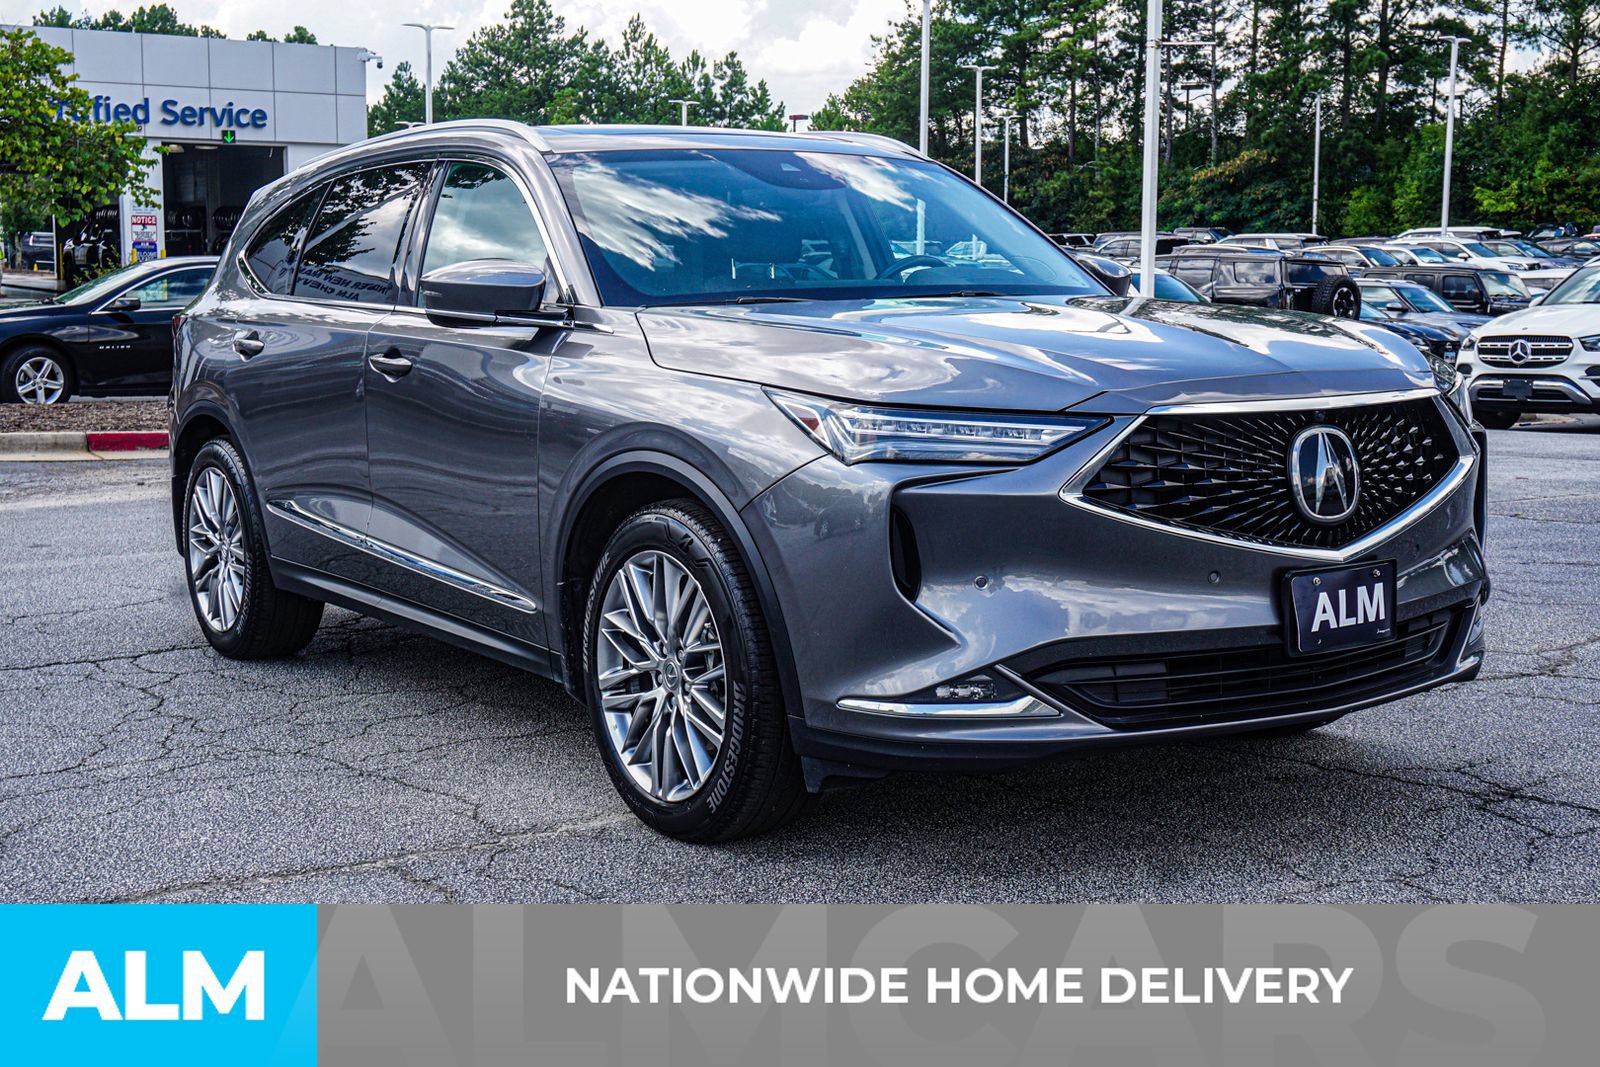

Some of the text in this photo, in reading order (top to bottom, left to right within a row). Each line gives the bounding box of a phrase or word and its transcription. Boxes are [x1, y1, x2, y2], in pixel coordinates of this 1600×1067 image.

[161, 99, 268, 129] Service
[131, 216, 156, 224] NOTICE
[1311, 582, 1386, 633] ALM
[706, 680, 747, 814] BRIDGESTONE
